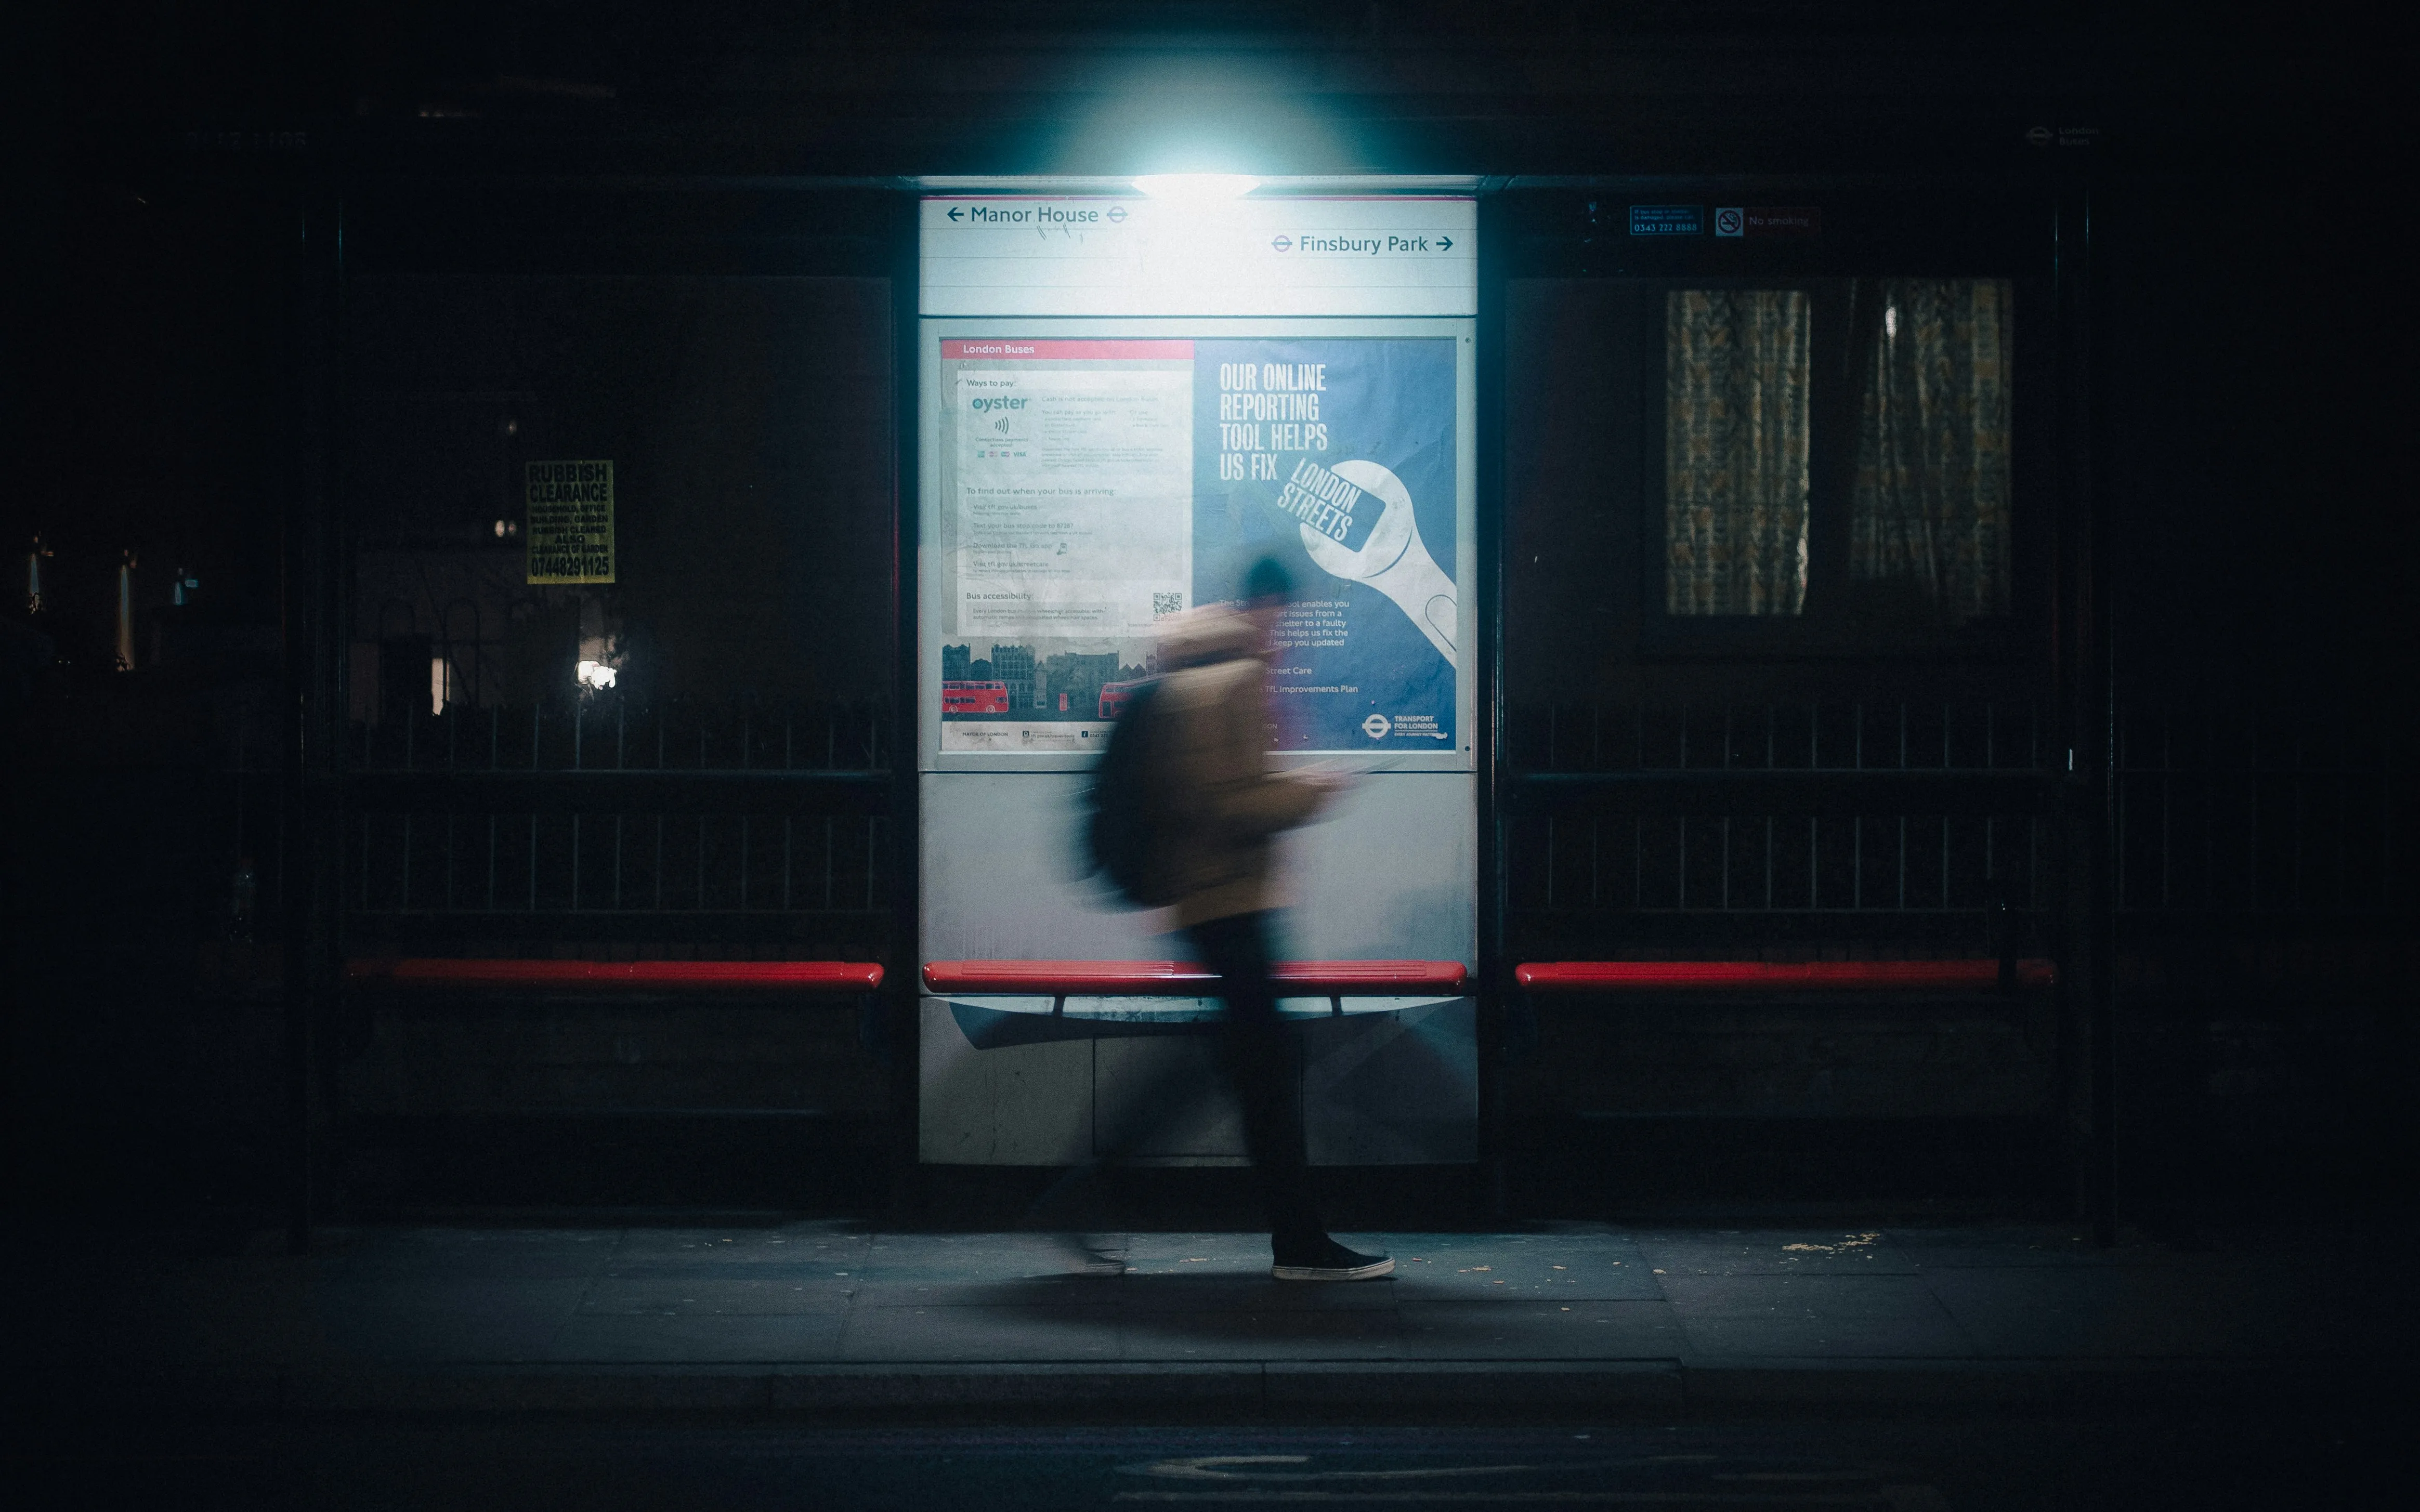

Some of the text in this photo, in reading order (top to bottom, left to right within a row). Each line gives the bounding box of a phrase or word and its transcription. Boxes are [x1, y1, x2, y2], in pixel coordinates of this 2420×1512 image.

[972, 206, 1098, 223] Manor House
[1749, 216, 1809, 227] No smoking
[1658, 223, 1672, 232] 222
[1300, 236, 1429, 255] Finsbury Park
[963, 345, 1035, 353] London Buses
[966, 379, 987, 388] Ways
[1220, 363, 1326, 391] OUR ONLINE
[972, 395, 1028, 413] oyster
[1220, 393, 1319, 422] REPORTING
[1220, 423, 1328, 451] TOOL HELPS
[529, 464, 607, 483] RUBBISH
[1220, 453, 1278, 481] US FIX
[530, 483, 607, 503] CLEARANCE
[1290, 457, 1362, 513] LONDON
[1277, 482, 1353, 542] STREETS
[532, 526, 568, 535] RUBBISH
[555, 535, 585, 544] ALSO
[532, 545, 608, 554] CLEARANCE OF GARDEN
[531, 556, 609, 576] 07448291125
[1322, 620, 1346, 628] faulty
[1287, 629, 1309, 638] helps
[1274, 639, 1292, 648] keep
[1312, 639, 1344, 648] updated
[1279, 686, 1339, 694] Improvements
